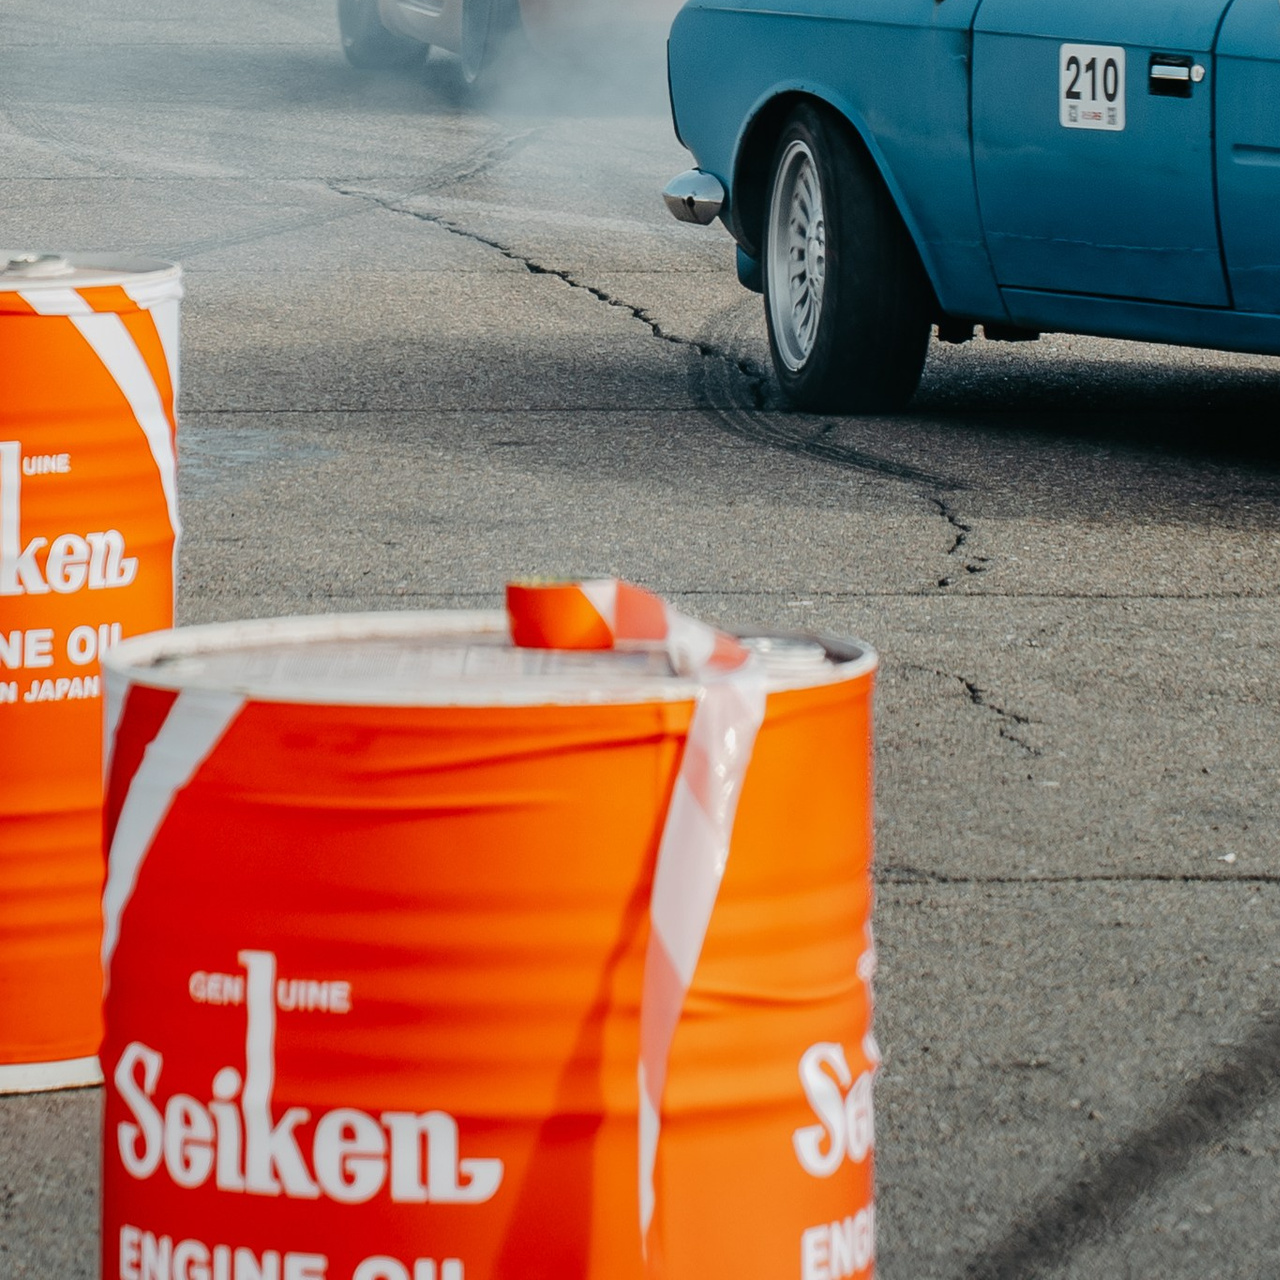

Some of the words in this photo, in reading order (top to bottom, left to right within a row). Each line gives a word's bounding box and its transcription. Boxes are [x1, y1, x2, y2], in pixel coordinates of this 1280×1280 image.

[1065, 55, 1118, 103] 210
[23, 675, 101, 703] JAPAN
[114, 949, 505, 1204] Seiken
